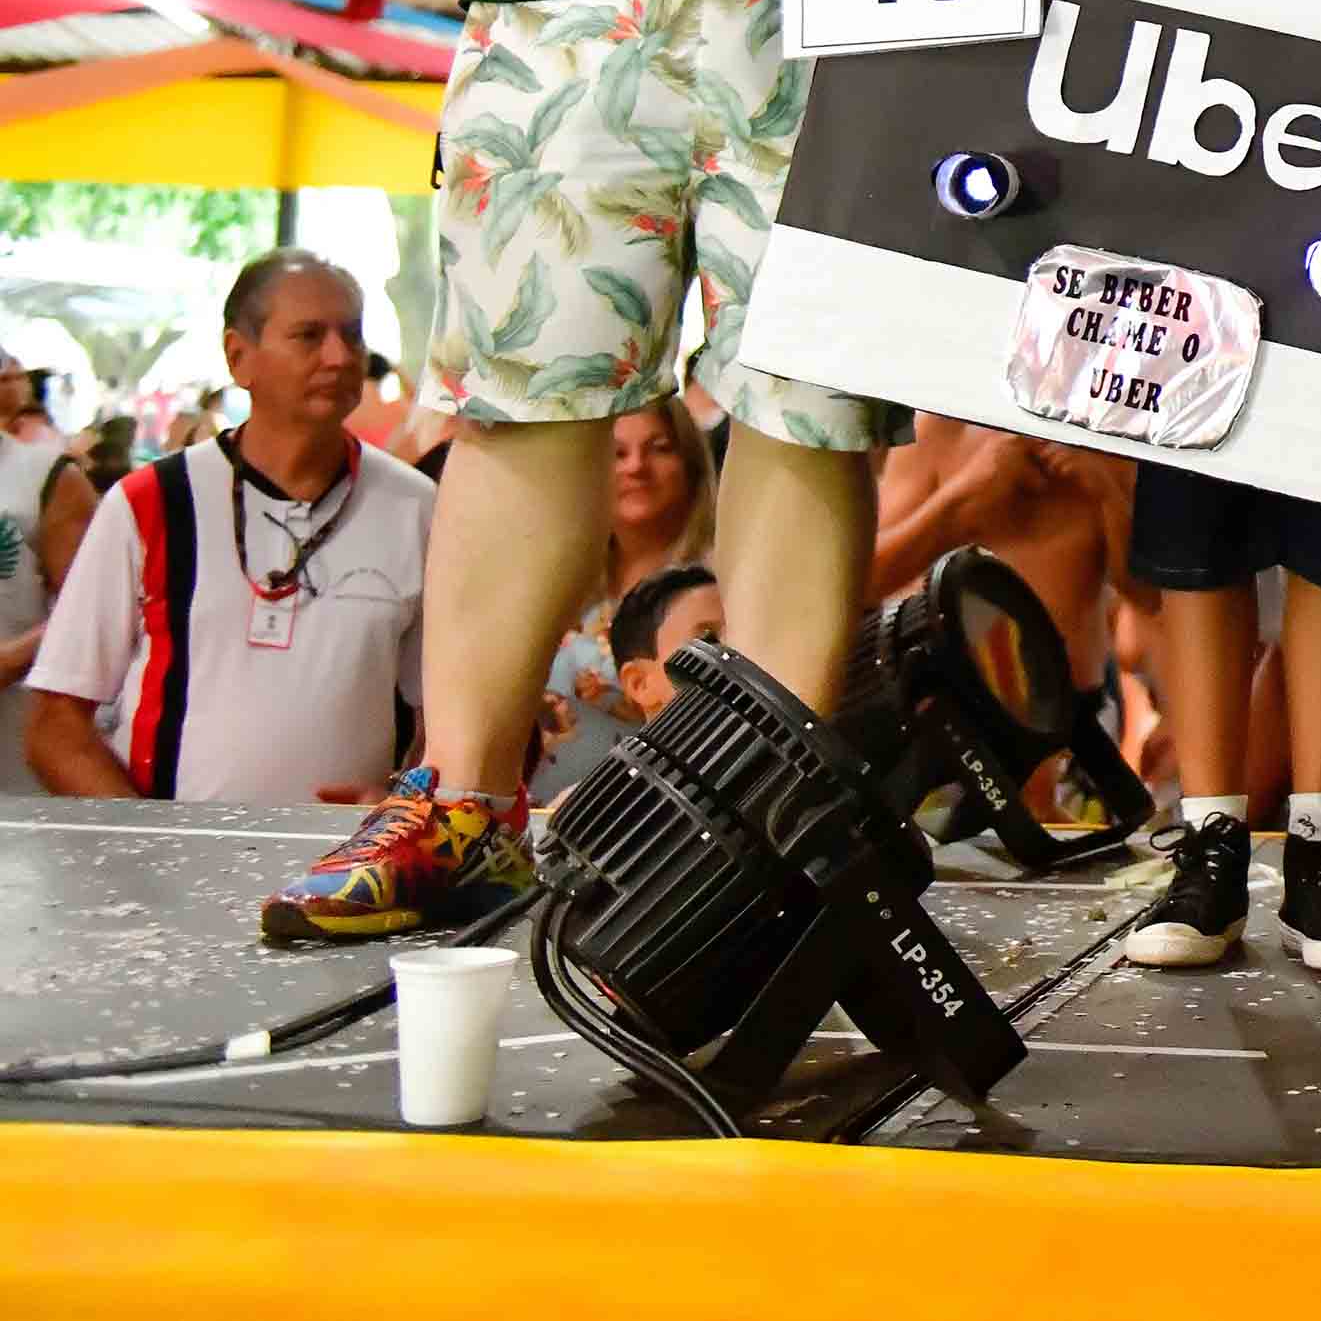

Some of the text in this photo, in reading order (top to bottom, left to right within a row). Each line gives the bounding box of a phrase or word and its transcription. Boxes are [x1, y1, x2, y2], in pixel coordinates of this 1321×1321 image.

[1052, 265, 1193, 323] SE BEBER
[1089, 367, 1163, 413] UBER
[960, 749, 1008, 812] LP-354
[890, 928, 965, 1018] LP-354
